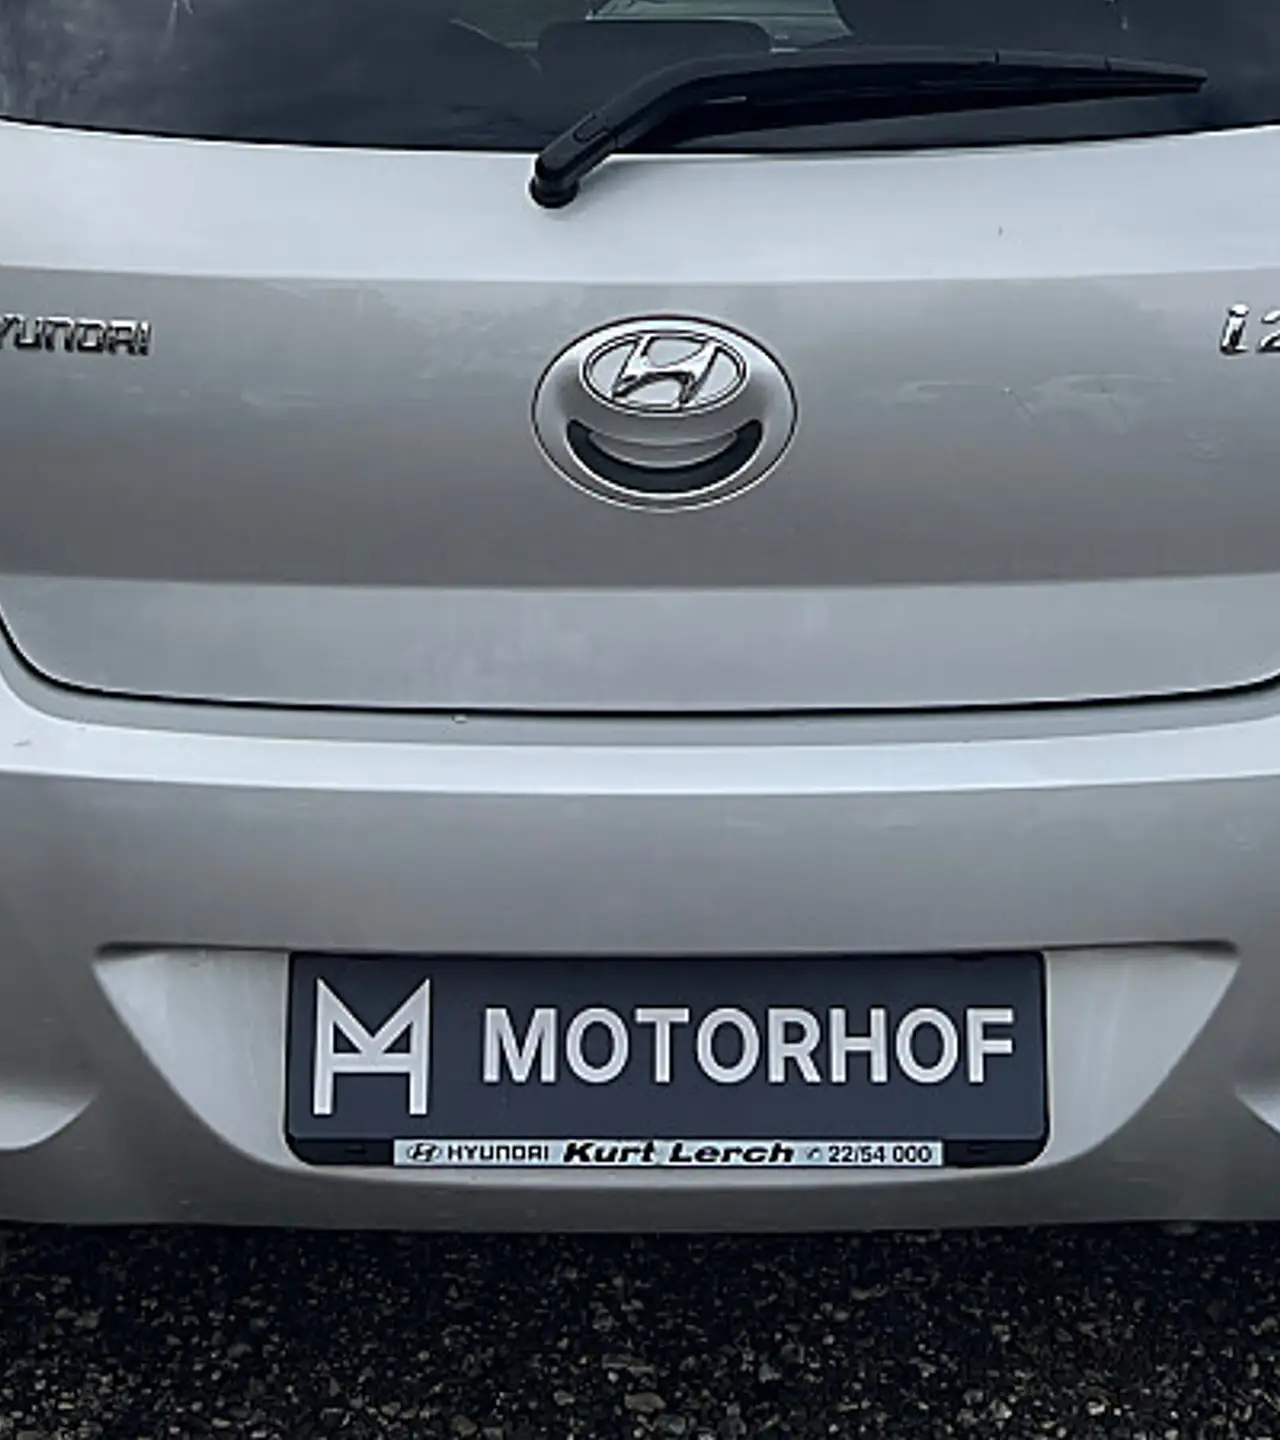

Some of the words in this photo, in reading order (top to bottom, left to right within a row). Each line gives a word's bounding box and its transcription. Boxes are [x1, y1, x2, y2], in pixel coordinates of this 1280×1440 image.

[482, 1006, 1016, 1084] MOTORHOF
[447, 1144, 550, 1162] HYUNDAI
[563, 1139, 657, 1163] Kurt
[668, 1140, 796, 1163] Lerch
[827, 1145, 888, 1163] 22/54
[891, 1145, 933, 1163] 000
